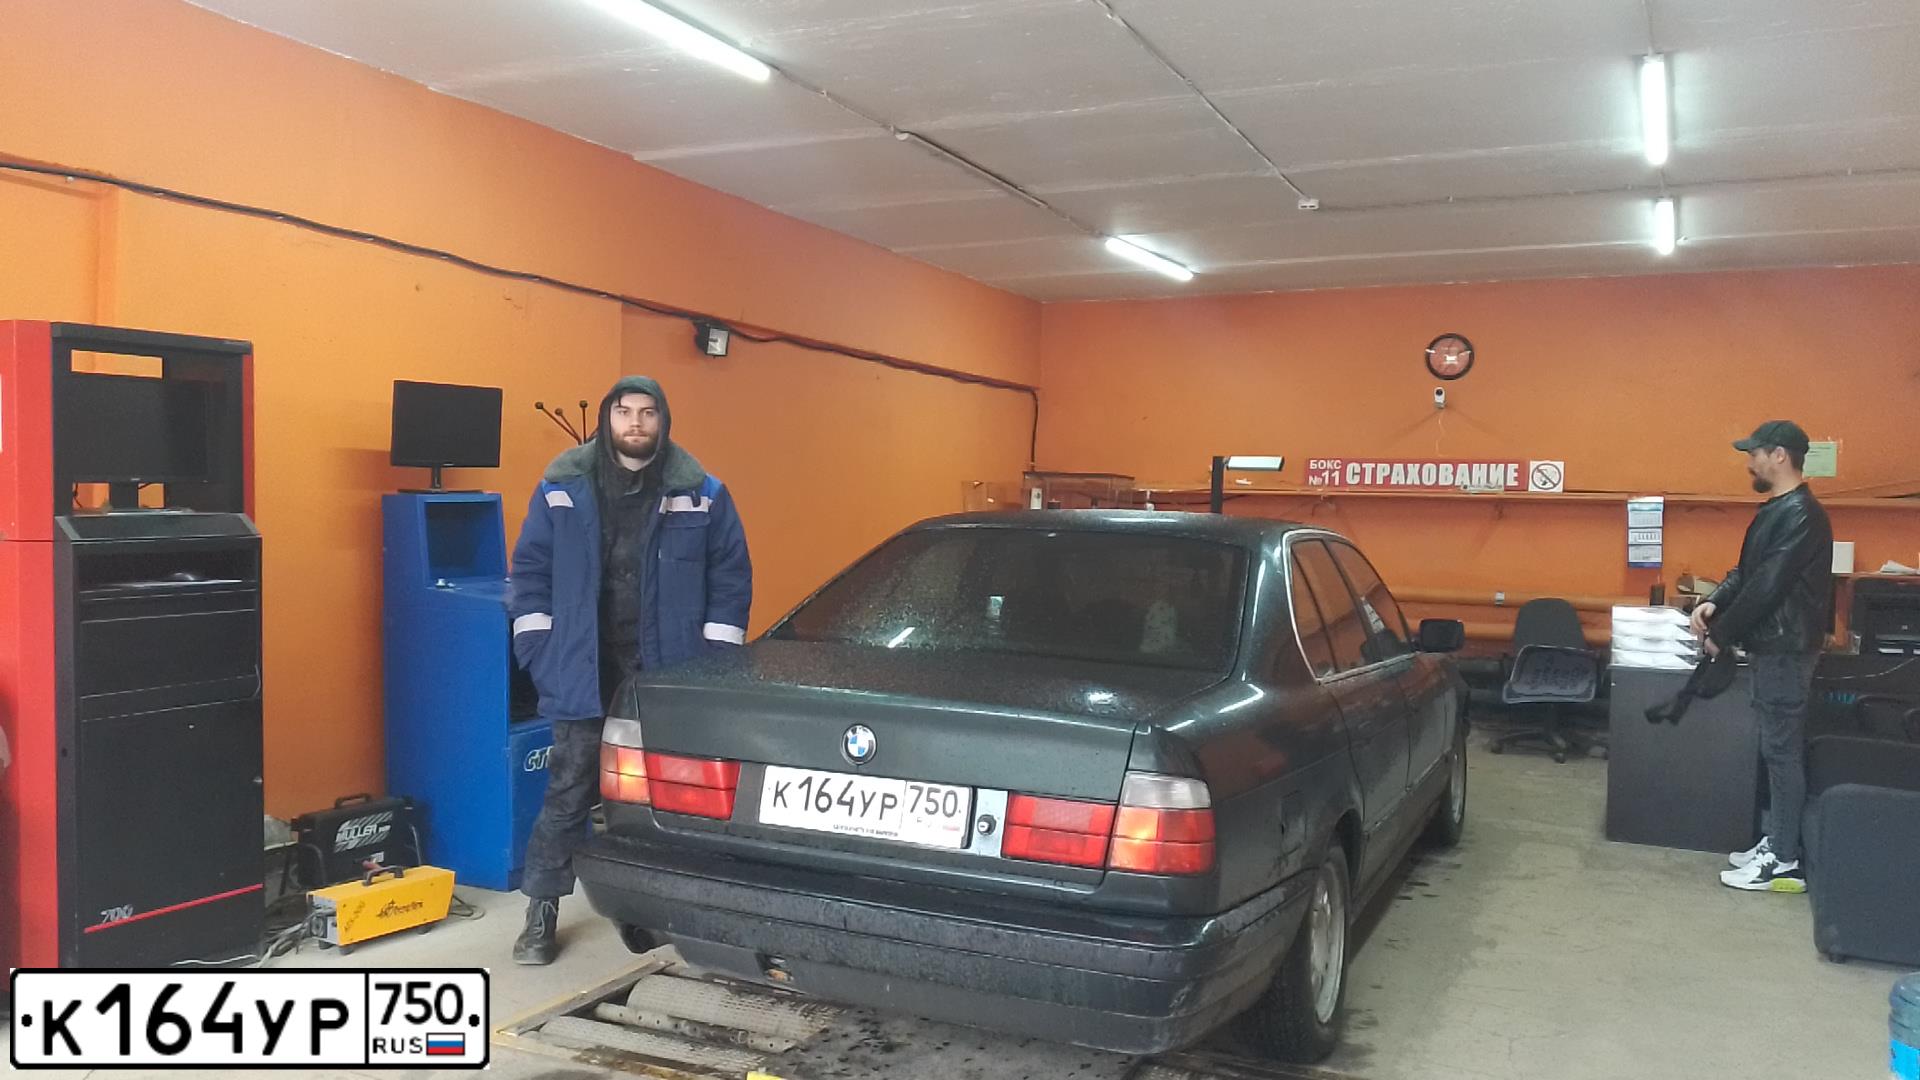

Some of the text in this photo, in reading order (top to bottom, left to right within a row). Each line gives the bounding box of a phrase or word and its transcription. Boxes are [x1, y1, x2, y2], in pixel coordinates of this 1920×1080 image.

[1309, 459, 1342, 470] БОКС
[1345, 462, 1519, 487] СТРАХОВАНИЕ
[1308, 470, 1340, 486] №11
[772, 775, 959, 820] К164УР 750
